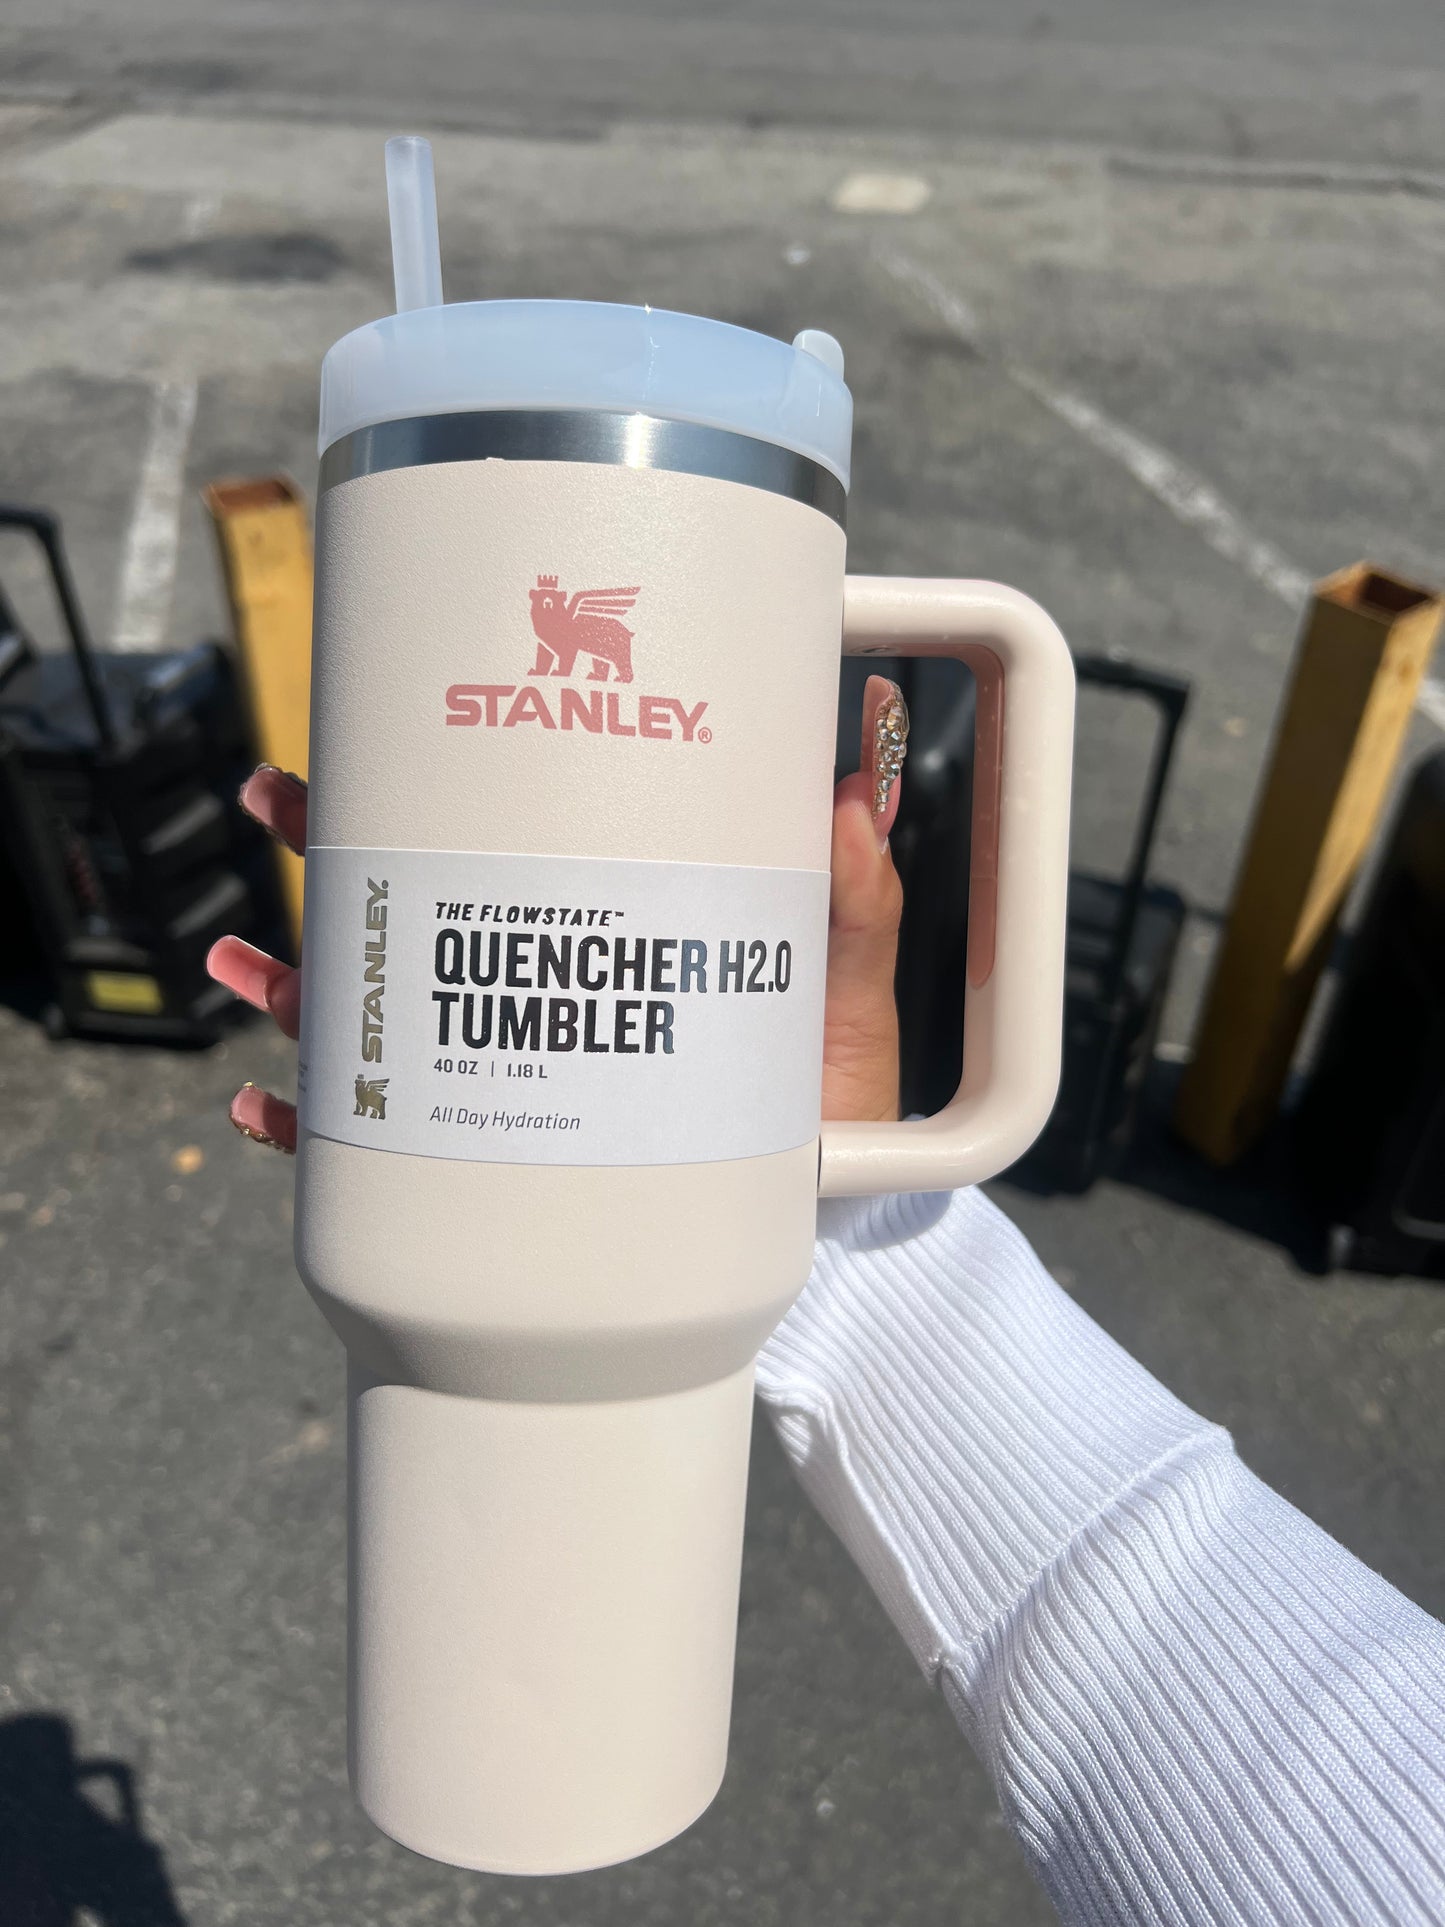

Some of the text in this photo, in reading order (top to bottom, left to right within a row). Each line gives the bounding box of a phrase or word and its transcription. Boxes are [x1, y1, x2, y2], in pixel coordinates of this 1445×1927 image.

[435, 901, 474, 921] THE
[434, 928, 792, 993] QUENCHER H2.0
[431, 991, 675, 1054] TUMBLER
[433, 1058, 548, 1079] 40 OZ 1.18 L
[429, 1105, 581, 1132] All Day Hydration
